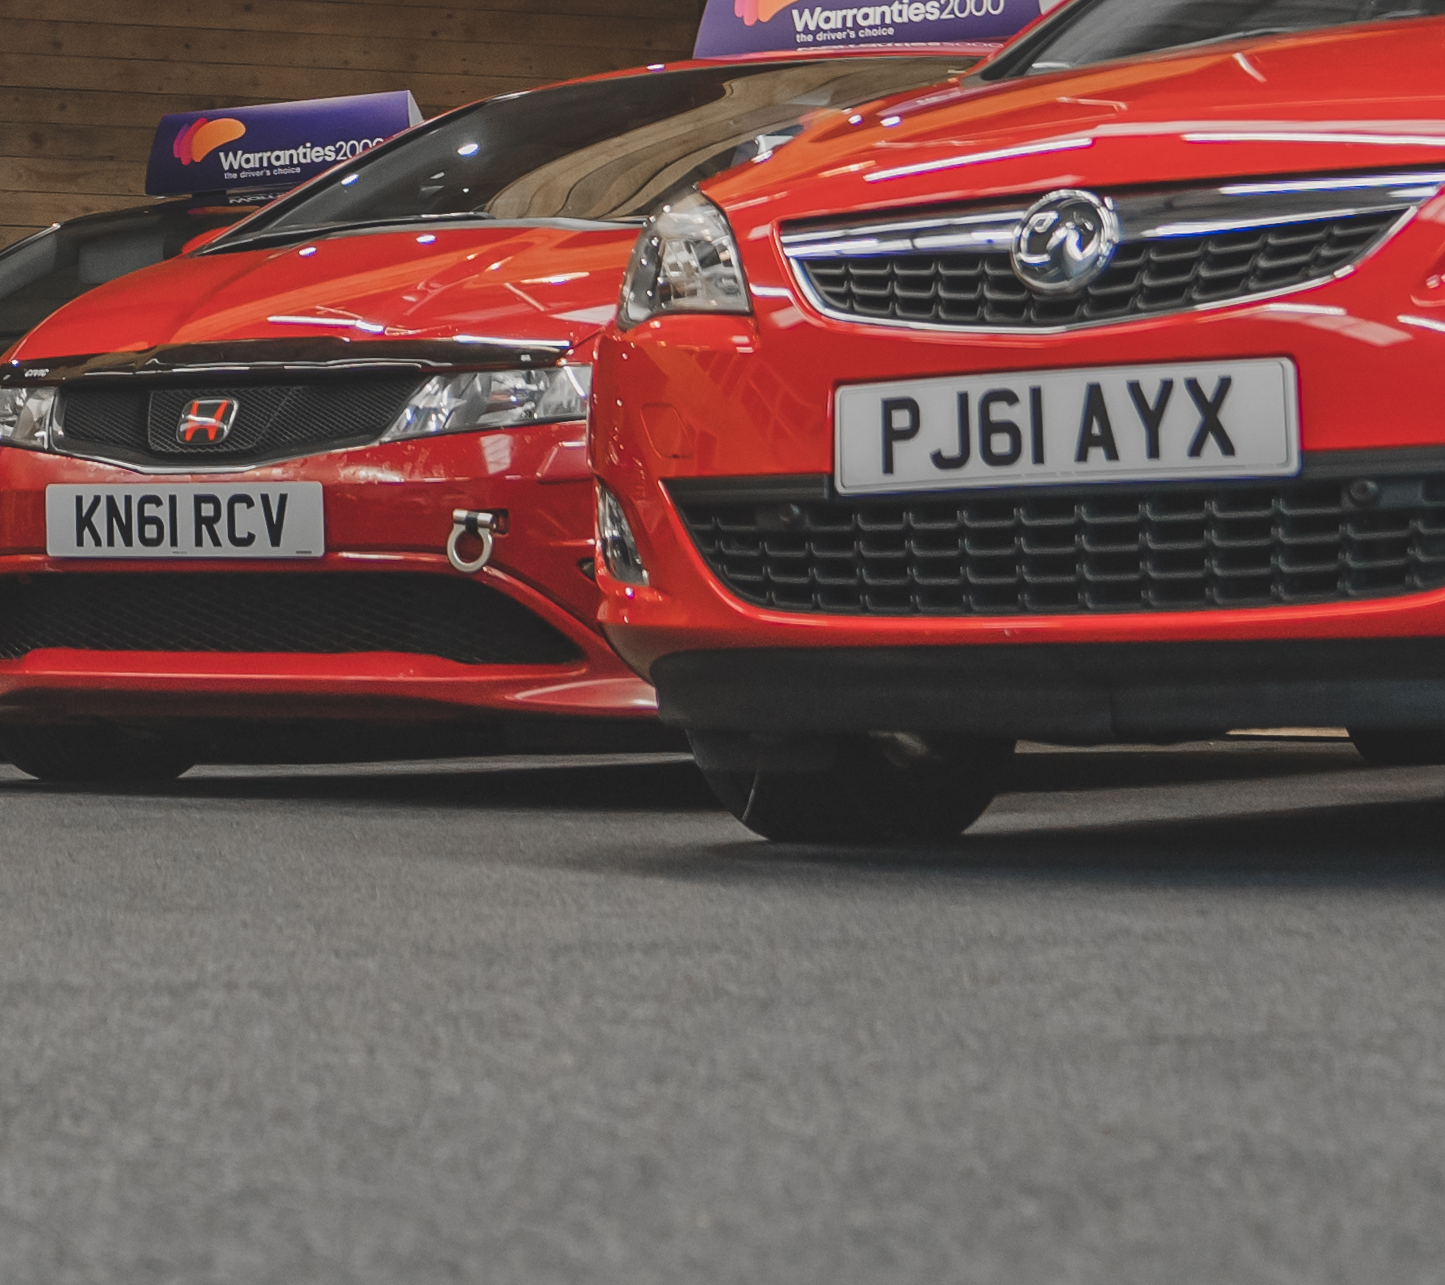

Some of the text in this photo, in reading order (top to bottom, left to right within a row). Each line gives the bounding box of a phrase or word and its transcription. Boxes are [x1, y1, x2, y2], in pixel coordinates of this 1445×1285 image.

[795, 26, 895, 43] the driver's choice
[224, 166, 301, 179] the driver's choice
[880, 376, 1236, 475] PJ61 AYX
[75, 492, 288, 548] KN61 RCV
